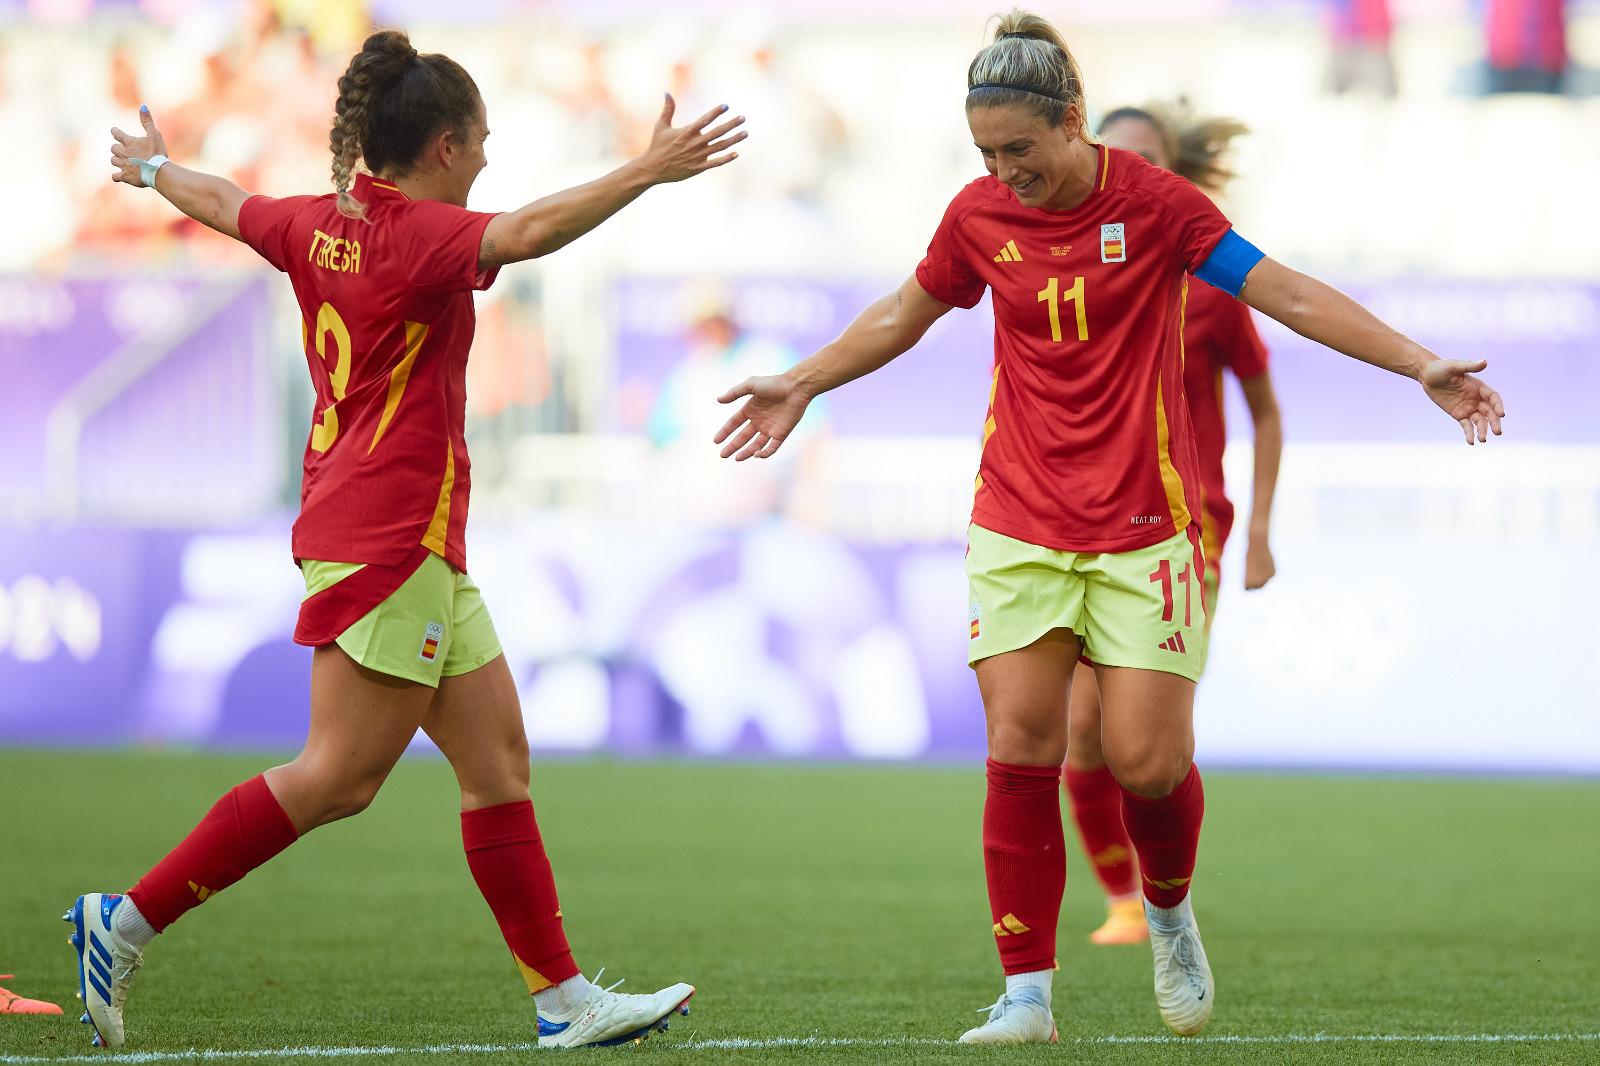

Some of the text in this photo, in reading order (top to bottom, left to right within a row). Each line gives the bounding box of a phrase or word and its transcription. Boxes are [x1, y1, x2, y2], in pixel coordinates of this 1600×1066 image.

[1037, 276, 1089, 342] 11
[311, 301, 351, 454] 3
[1148, 559, 1191, 628] 11
